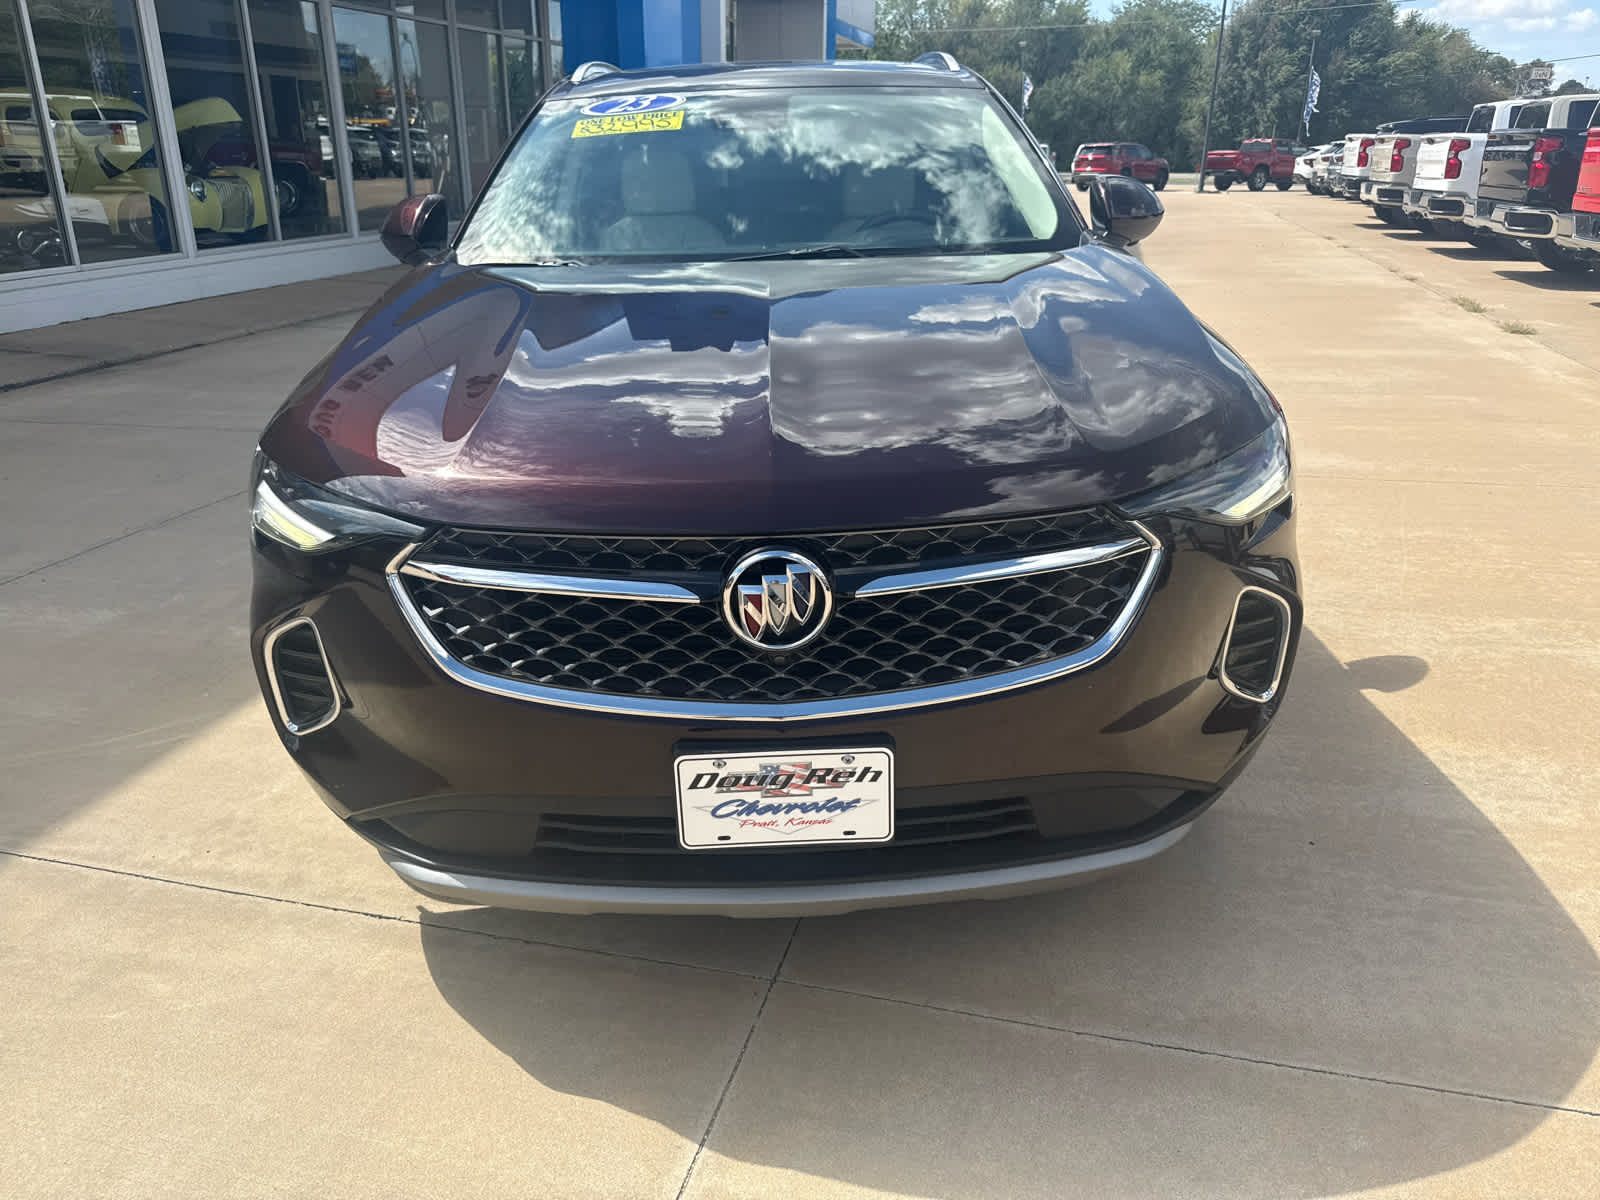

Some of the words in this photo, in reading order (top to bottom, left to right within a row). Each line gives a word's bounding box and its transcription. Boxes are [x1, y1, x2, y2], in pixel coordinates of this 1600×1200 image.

[605, 95, 658, 113] 23
[610, 114, 640, 122] LOW
[643, 111, 679, 119] PRICE
[687, 772, 796, 790] Doug
[802, 767, 883, 785] Reh
[710, 797, 861, 819] Chevrolet
[784, 818, 833, 826] Kansas
